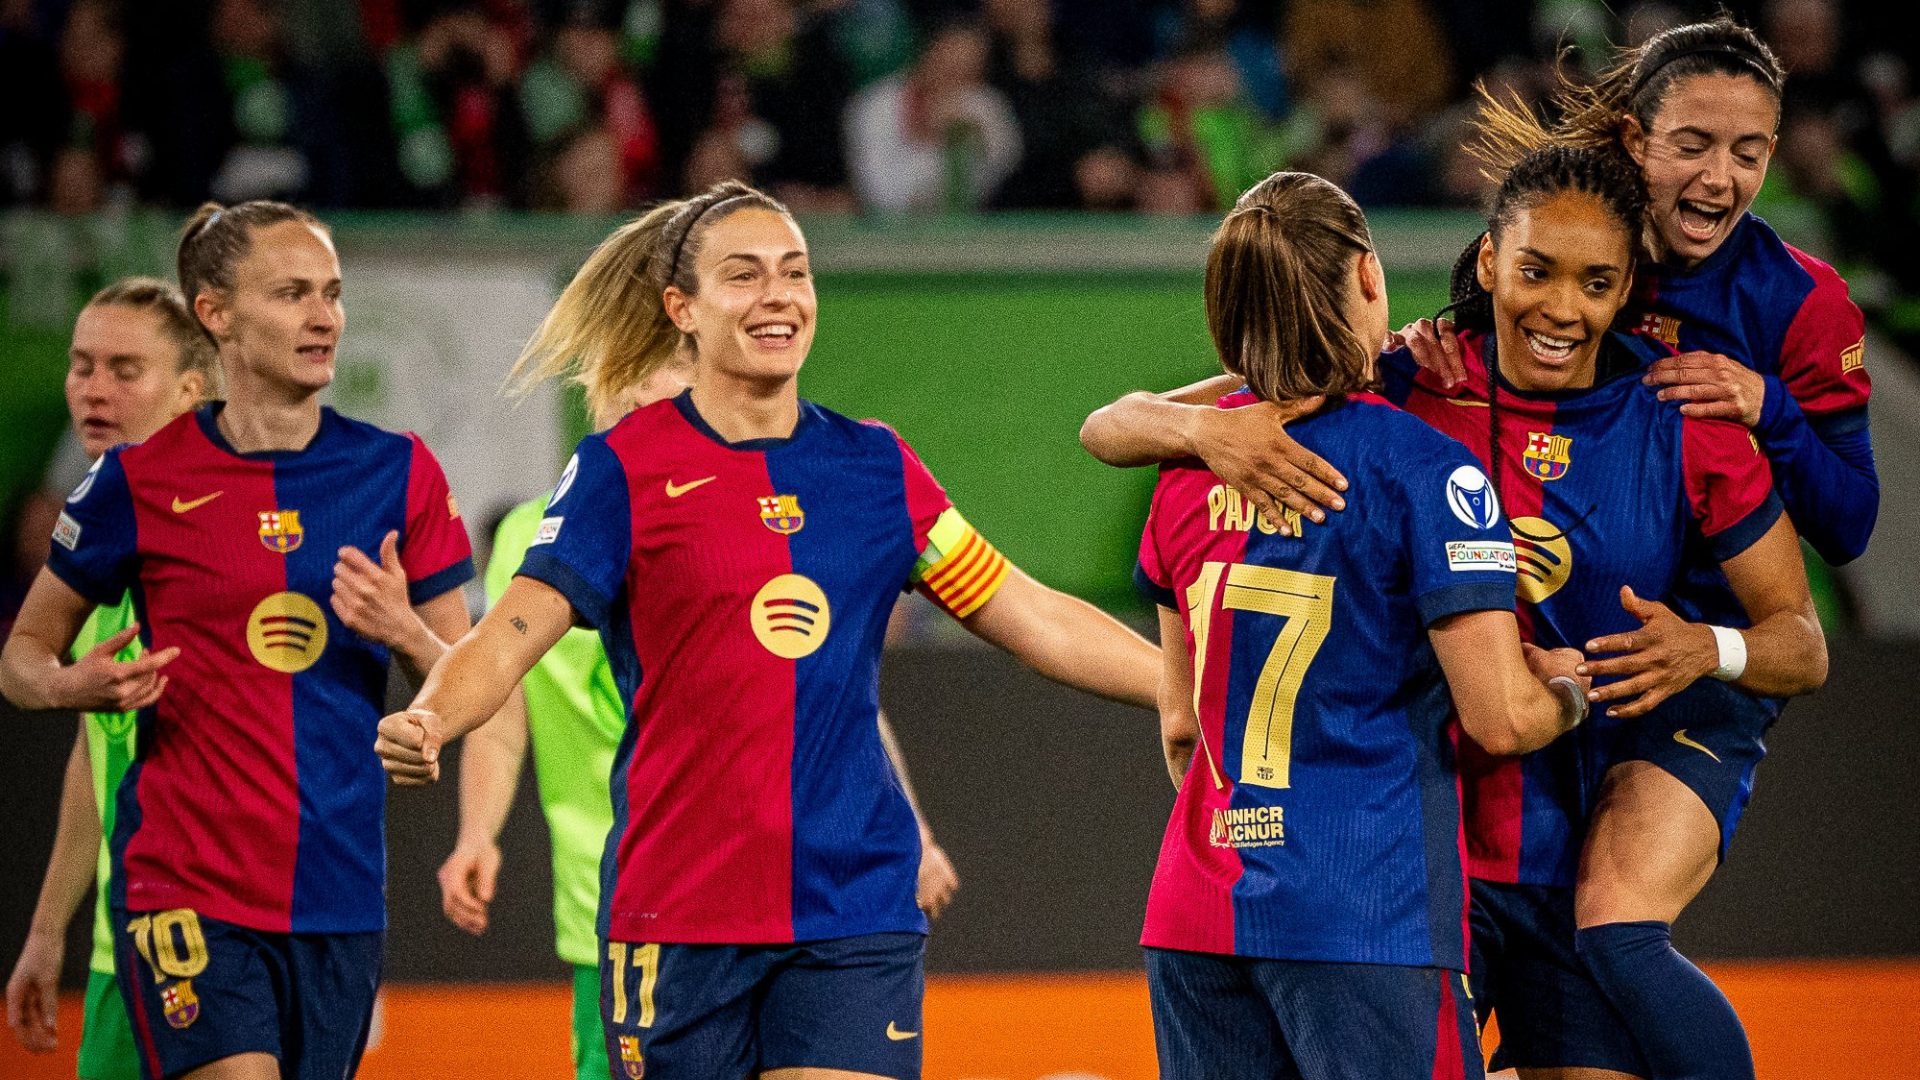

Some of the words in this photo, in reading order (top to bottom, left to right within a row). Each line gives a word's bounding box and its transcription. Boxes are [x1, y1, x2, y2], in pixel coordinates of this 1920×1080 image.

[1449, 551, 1515, 562] FOUNDATION
[1186, 561, 1337, 789] 17
[1224, 806, 1284, 826] UNHCR
[1228, 822, 1285, 842] ACNUR
[126, 908, 209, 985] 10
[608, 942, 660, 1029] 11
